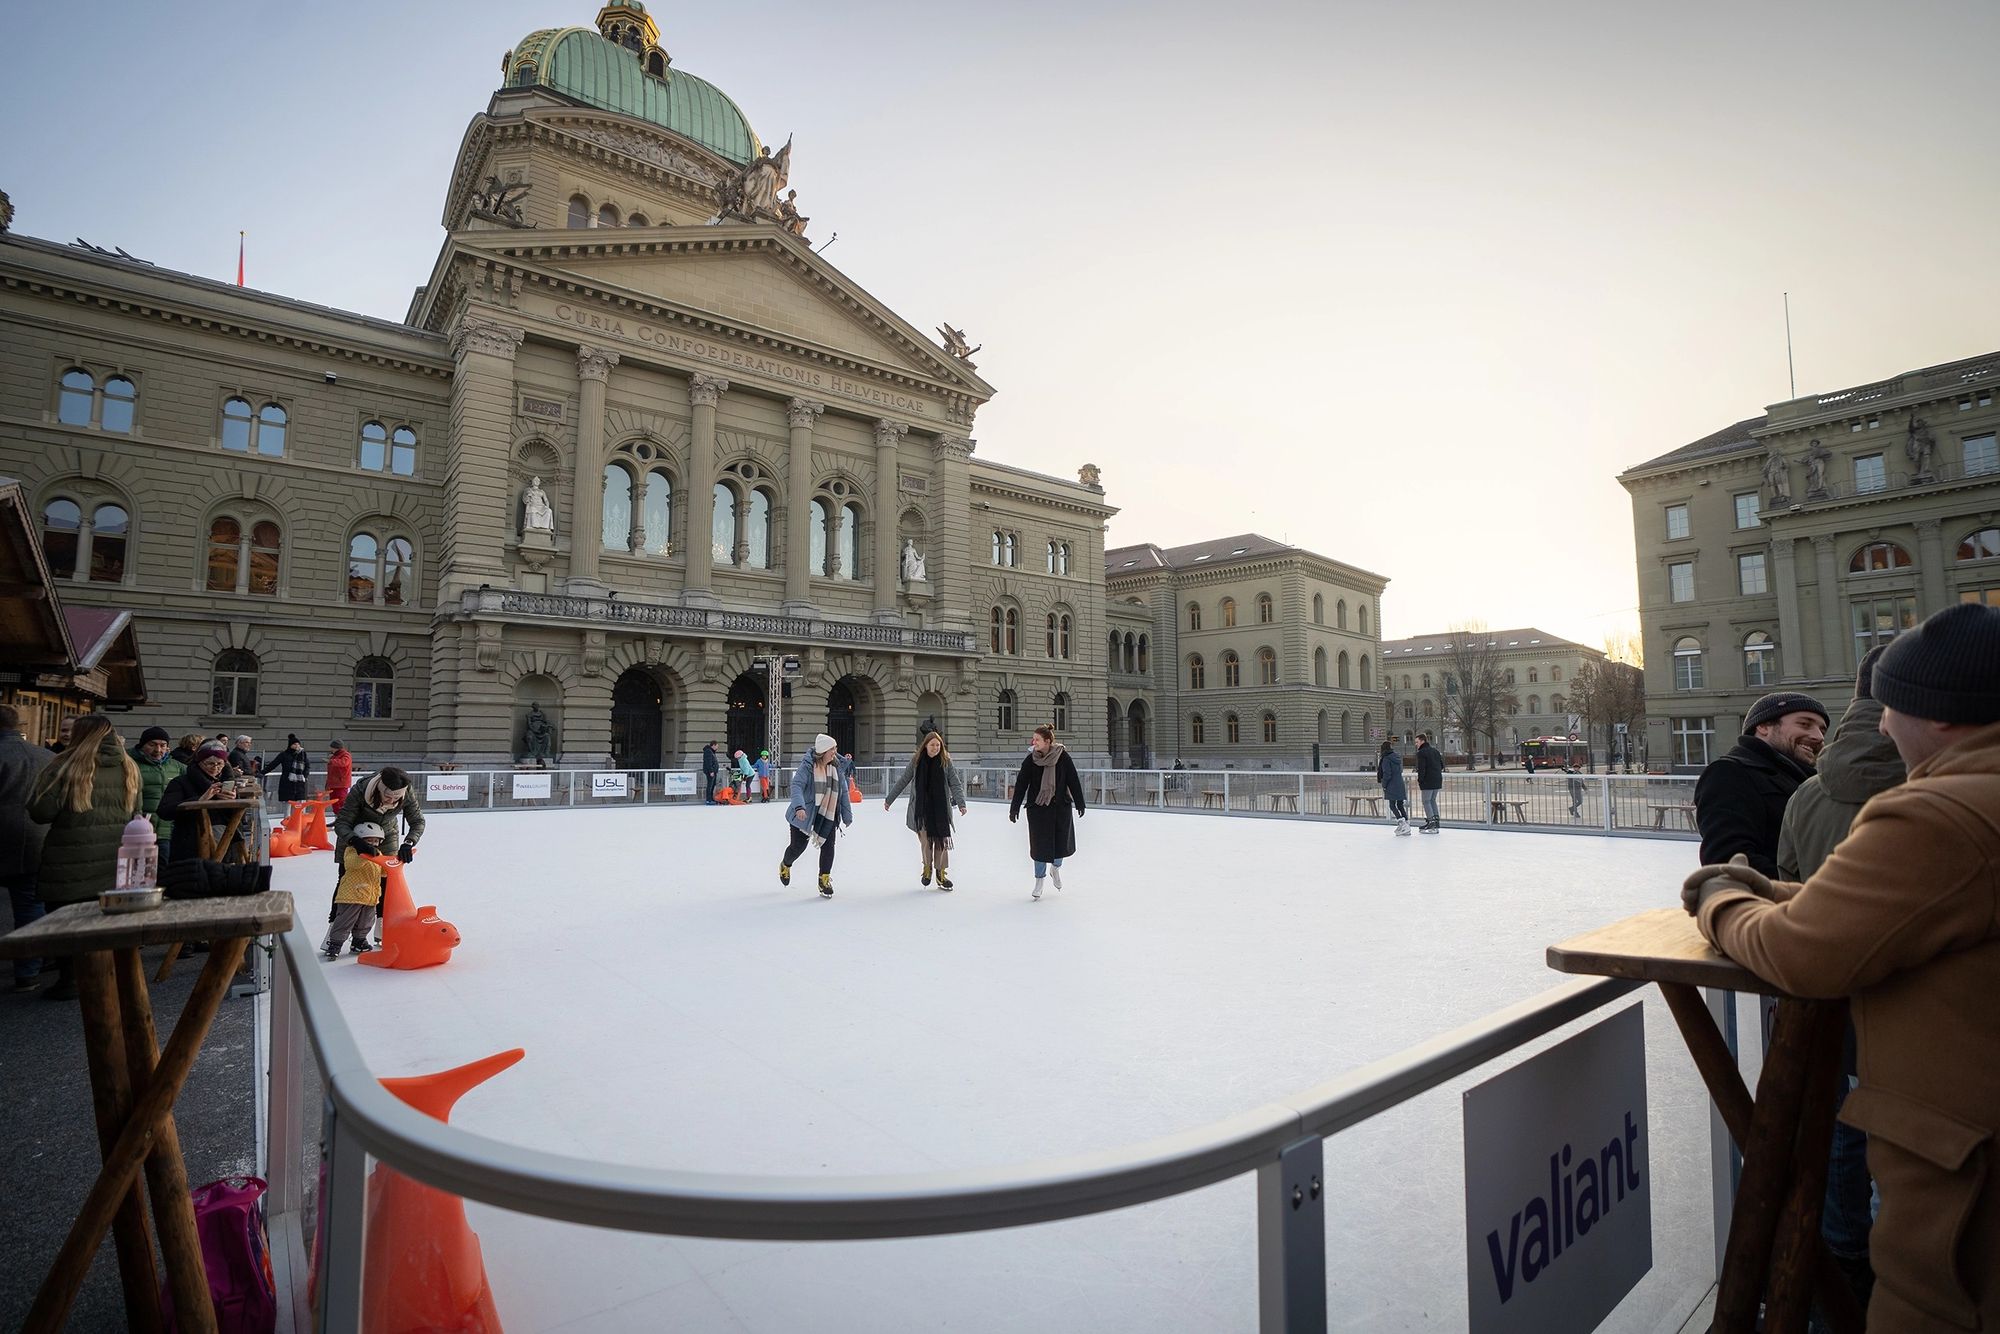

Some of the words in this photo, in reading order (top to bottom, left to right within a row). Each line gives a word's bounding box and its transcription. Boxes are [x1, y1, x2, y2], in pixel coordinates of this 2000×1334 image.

[556, 304, 625, 335] CURIA
[638, 326, 821, 385] CONFOEDERATIONIS
[830, 375, 924, 412] HELVETICAE
[442, 784, 466, 792] Behring
[595, 778, 624, 787] USL
[1487, 1111, 1640, 1304] valiant
